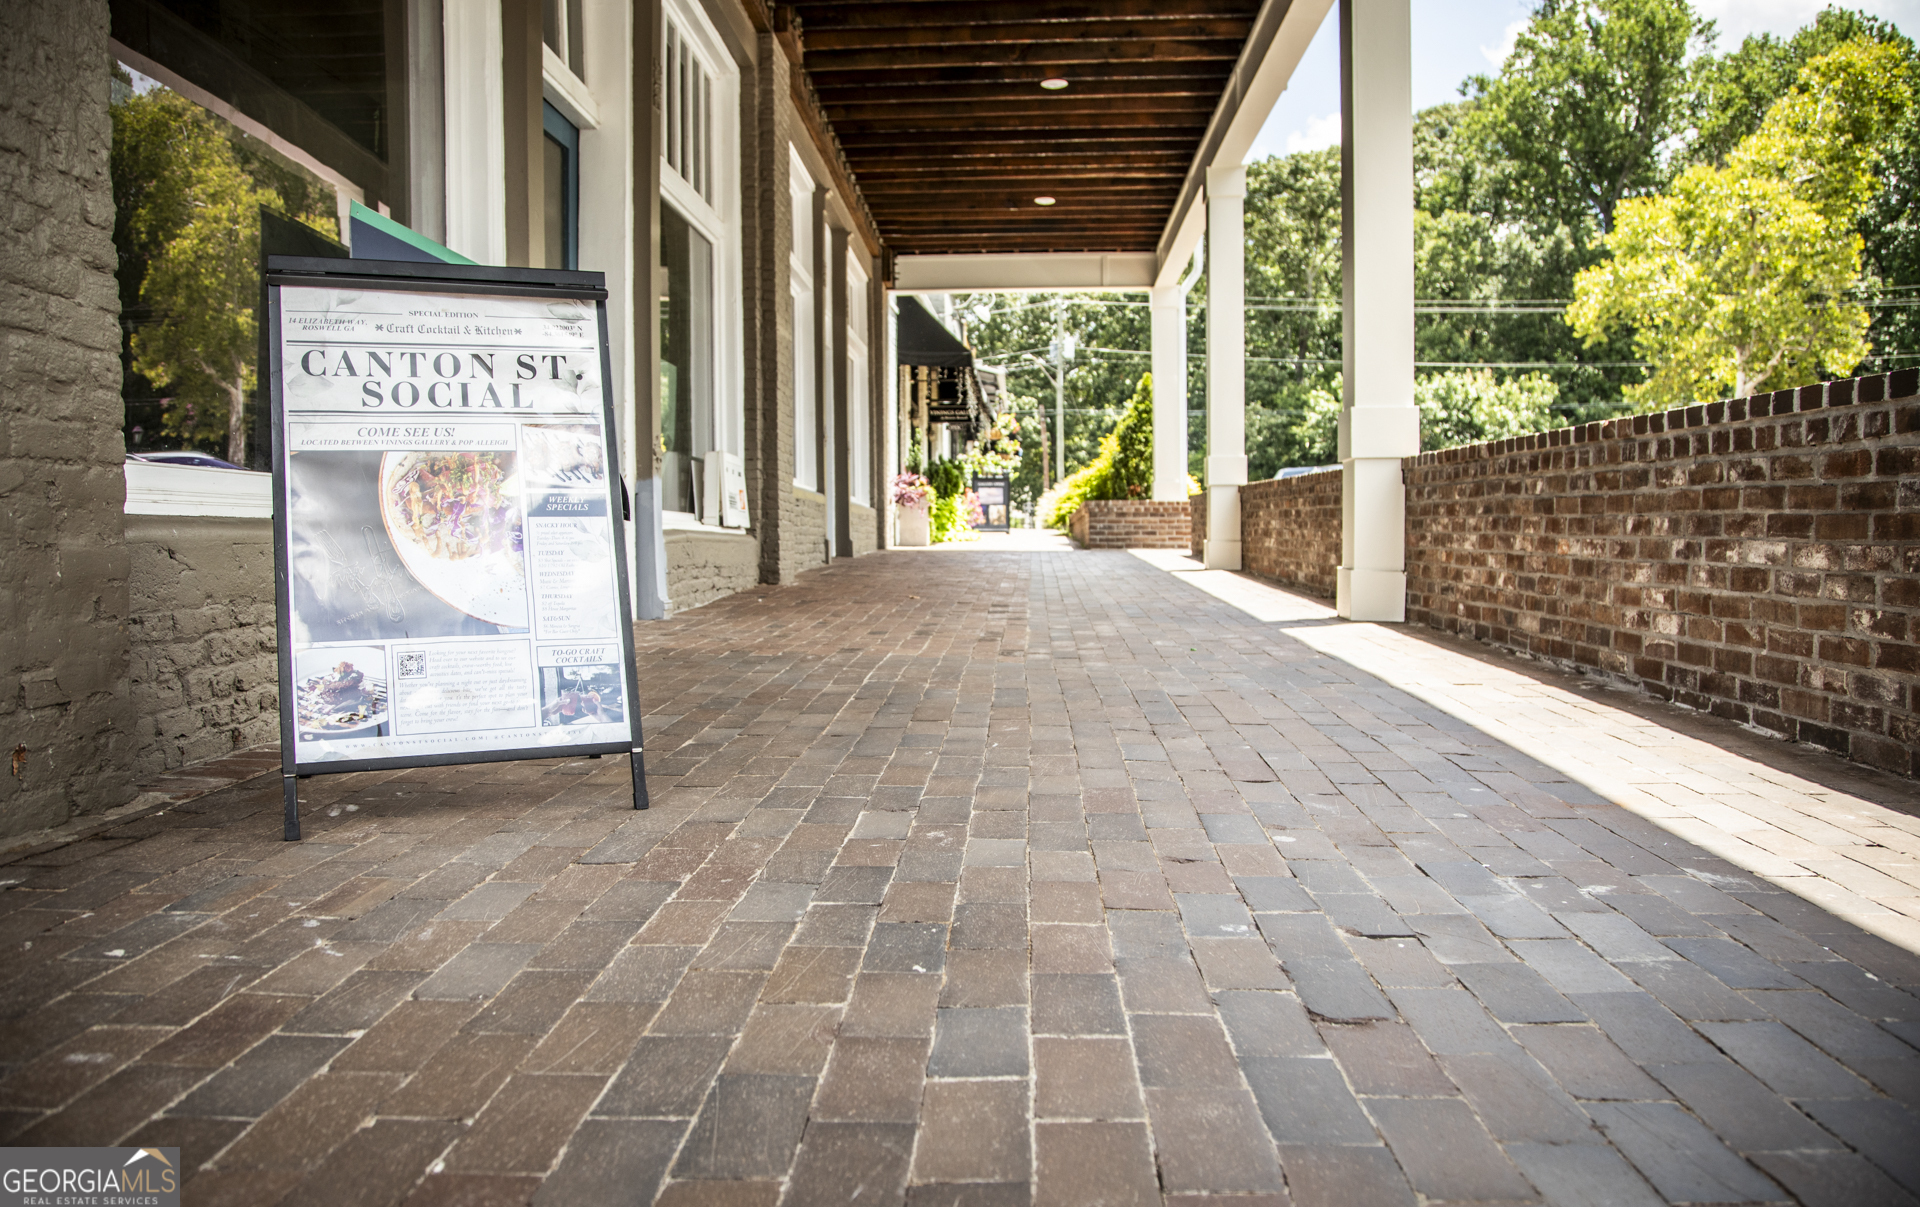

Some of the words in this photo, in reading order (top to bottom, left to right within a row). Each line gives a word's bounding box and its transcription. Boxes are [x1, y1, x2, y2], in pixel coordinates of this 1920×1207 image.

[386, 324, 414, 334] Craft
[417, 324, 460, 334] Cocktail
[463, 325, 471, 335] &
[475, 326, 513, 337] Kitchen
[300, 350, 496, 379] CANTON
[516, 354, 583, 380] ST.
[361, 380, 534, 409] SOCIAL
[358, 427, 400, 437] COME
[404, 427, 430, 437] SEE
[434, 427, 455, 437] US!
[556, 656, 602, 664] COCKTAILS
[467, 700, 478, 708] find
